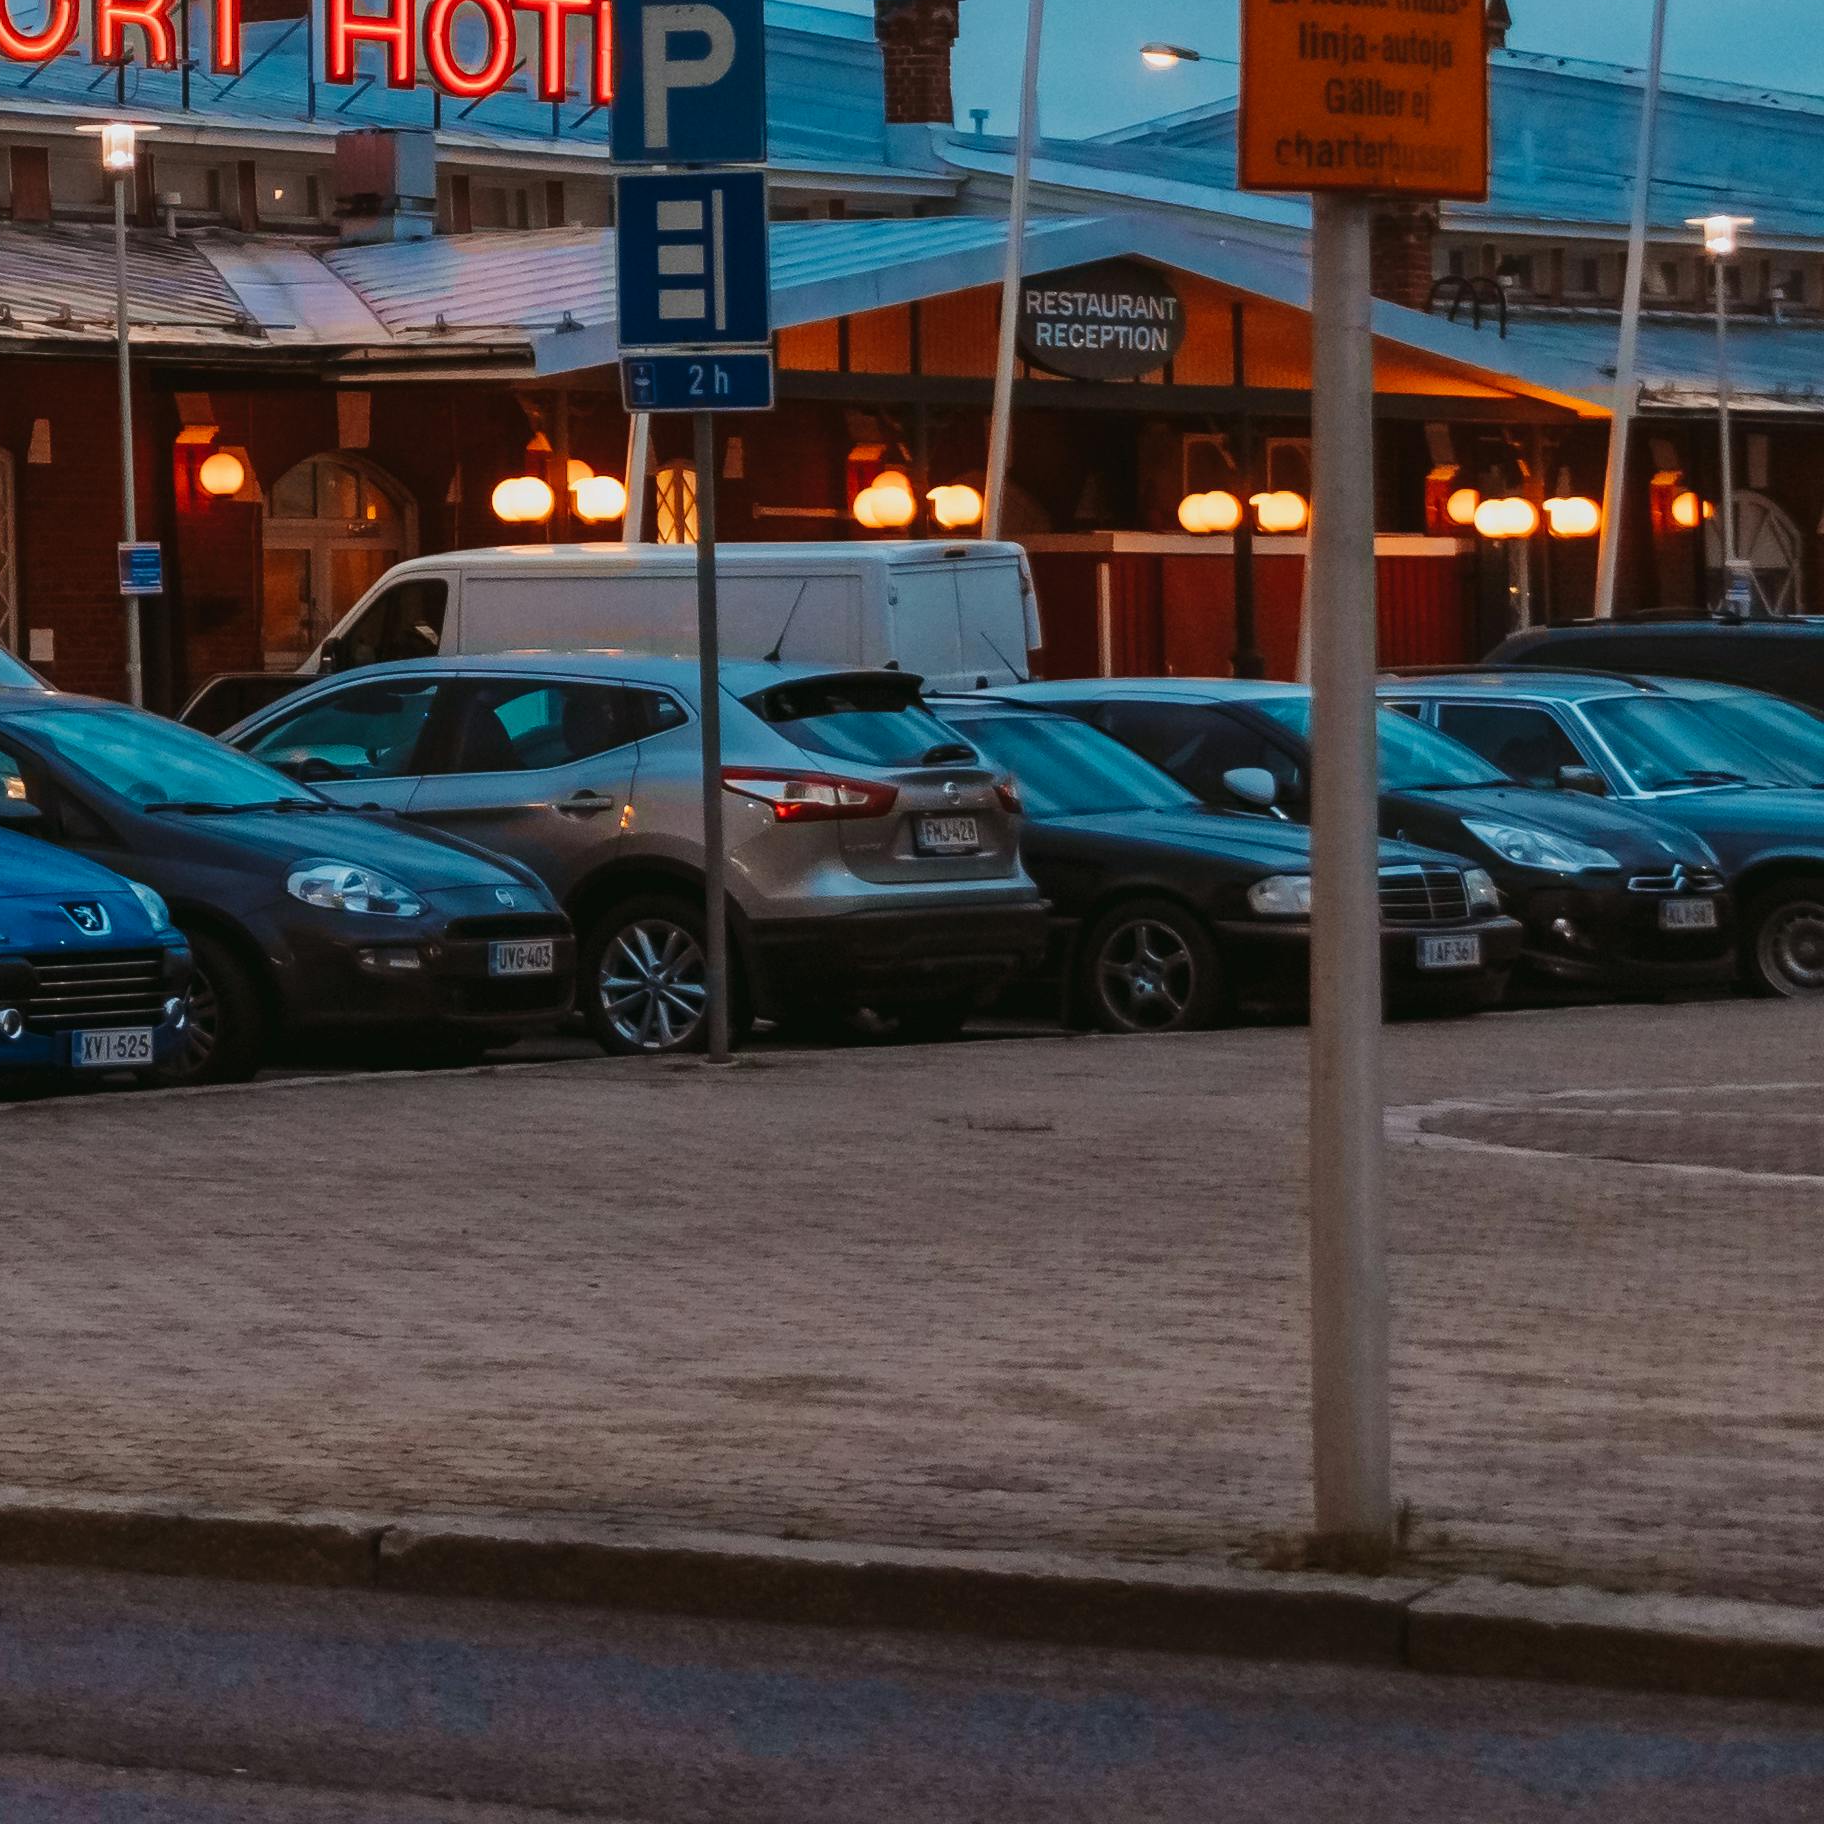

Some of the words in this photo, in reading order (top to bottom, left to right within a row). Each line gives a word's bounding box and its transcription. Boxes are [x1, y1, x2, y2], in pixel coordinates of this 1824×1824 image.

[1299, 22, 1453, 73] linja-autoja
[642, 5, 736, 148] P
[1325, 78, 1406, 117] Gäller
[1412, 84, 1432, 124] ej
[1025, 290, 1177, 321] RESTAURANT
[1035, 322, 1168, 351] RECEPTION
[83, 1034, 150, 1060] XVI-525
